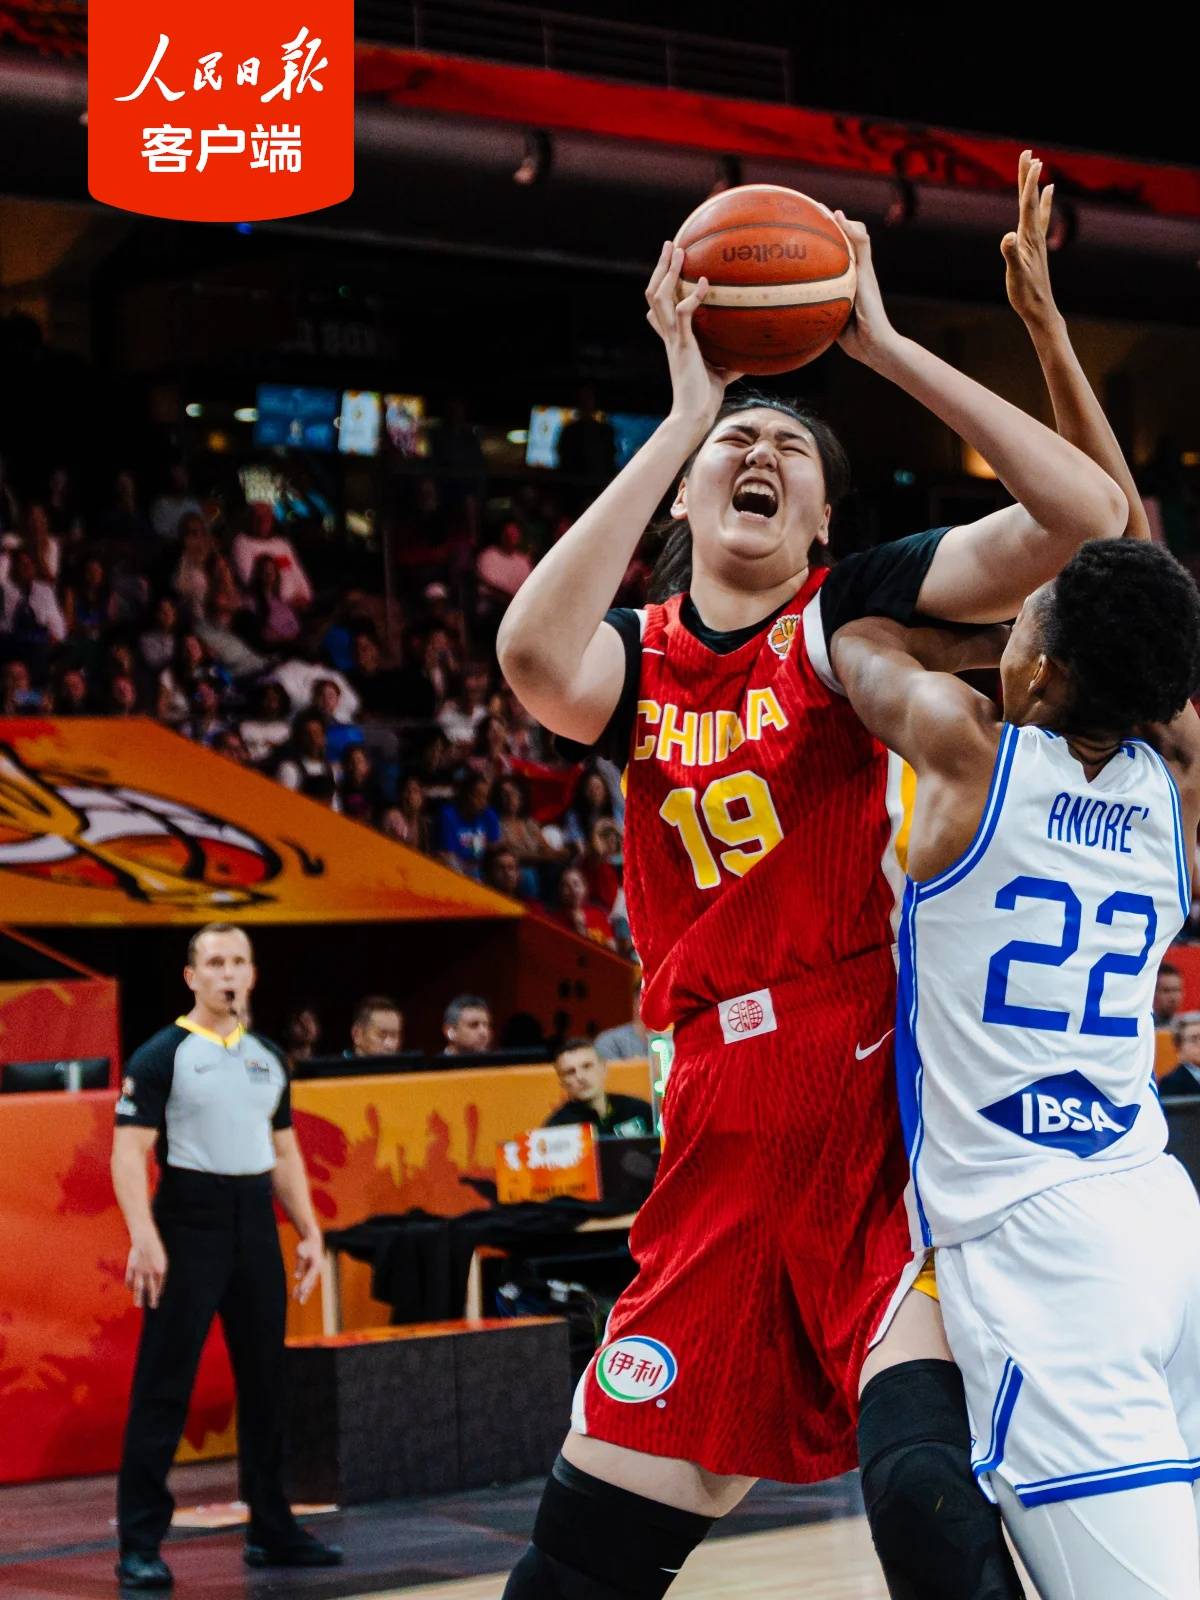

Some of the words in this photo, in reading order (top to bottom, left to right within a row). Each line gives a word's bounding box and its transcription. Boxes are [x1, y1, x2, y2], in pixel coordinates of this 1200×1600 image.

[720, 242, 808, 264] molten
[634, 686, 789, 767] CHINA
[658, 770, 785, 890] 19
[982, 874, 1158, 1038] 22
[1021, 1091, 1127, 1136] IBSA
[607, 1350, 664, 1388] 伊利
